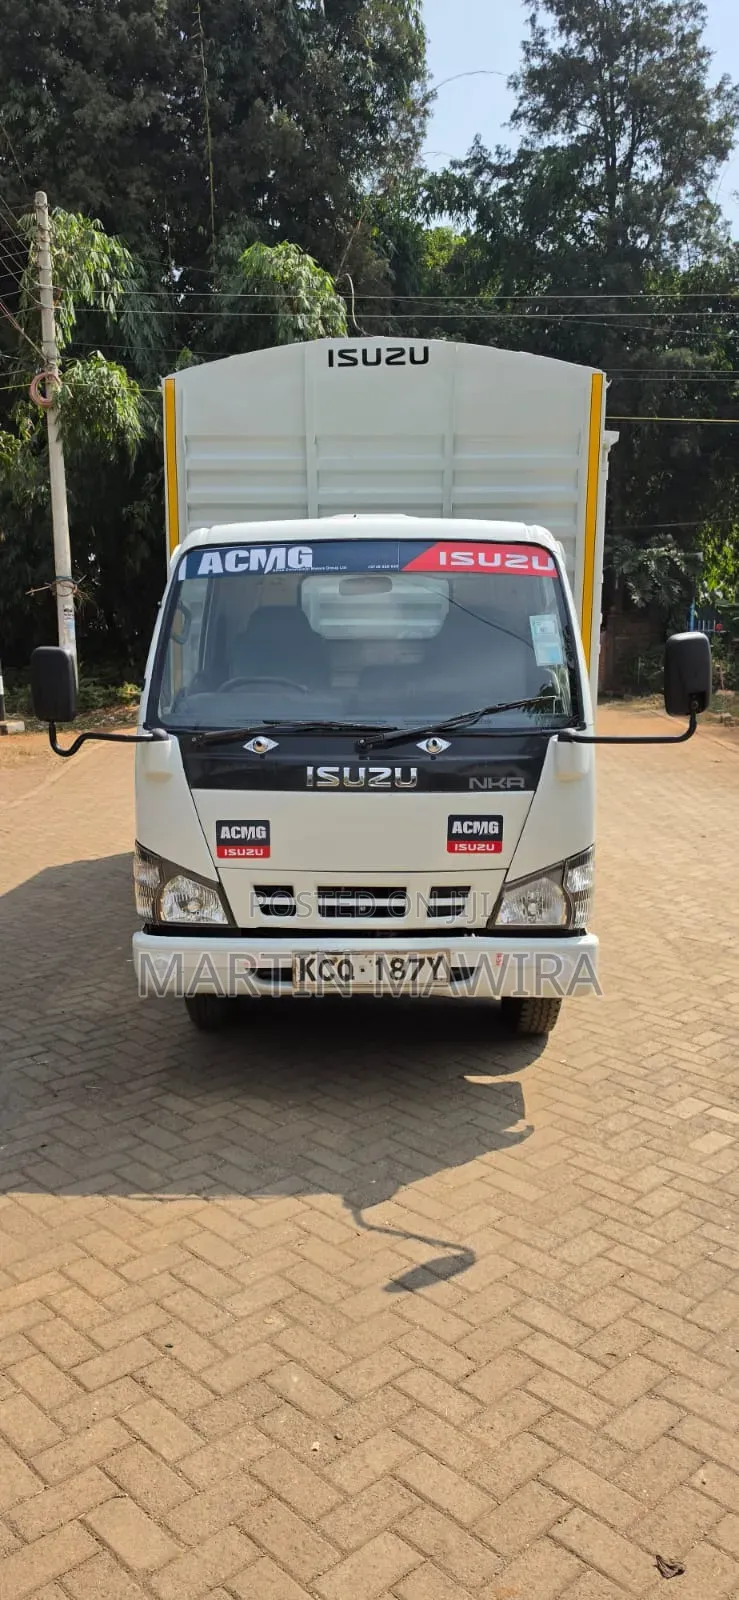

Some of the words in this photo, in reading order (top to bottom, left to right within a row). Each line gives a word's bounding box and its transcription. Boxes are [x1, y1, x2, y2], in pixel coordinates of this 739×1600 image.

[328, 346, 429, 368] ISUZU
[198, 546, 313, 575] ACMG
[439, 551, 556, 571] ISUZU
[306, 766, 418, 788] ISUZU
[469, 777, 525, 789] NKR
[220, 826, 266, 840] ACMG
[451, 821, 499, 836] ACMG
[454, 843, 495, 852] ISUZU
[375, 955, 444, 982] 187Y
